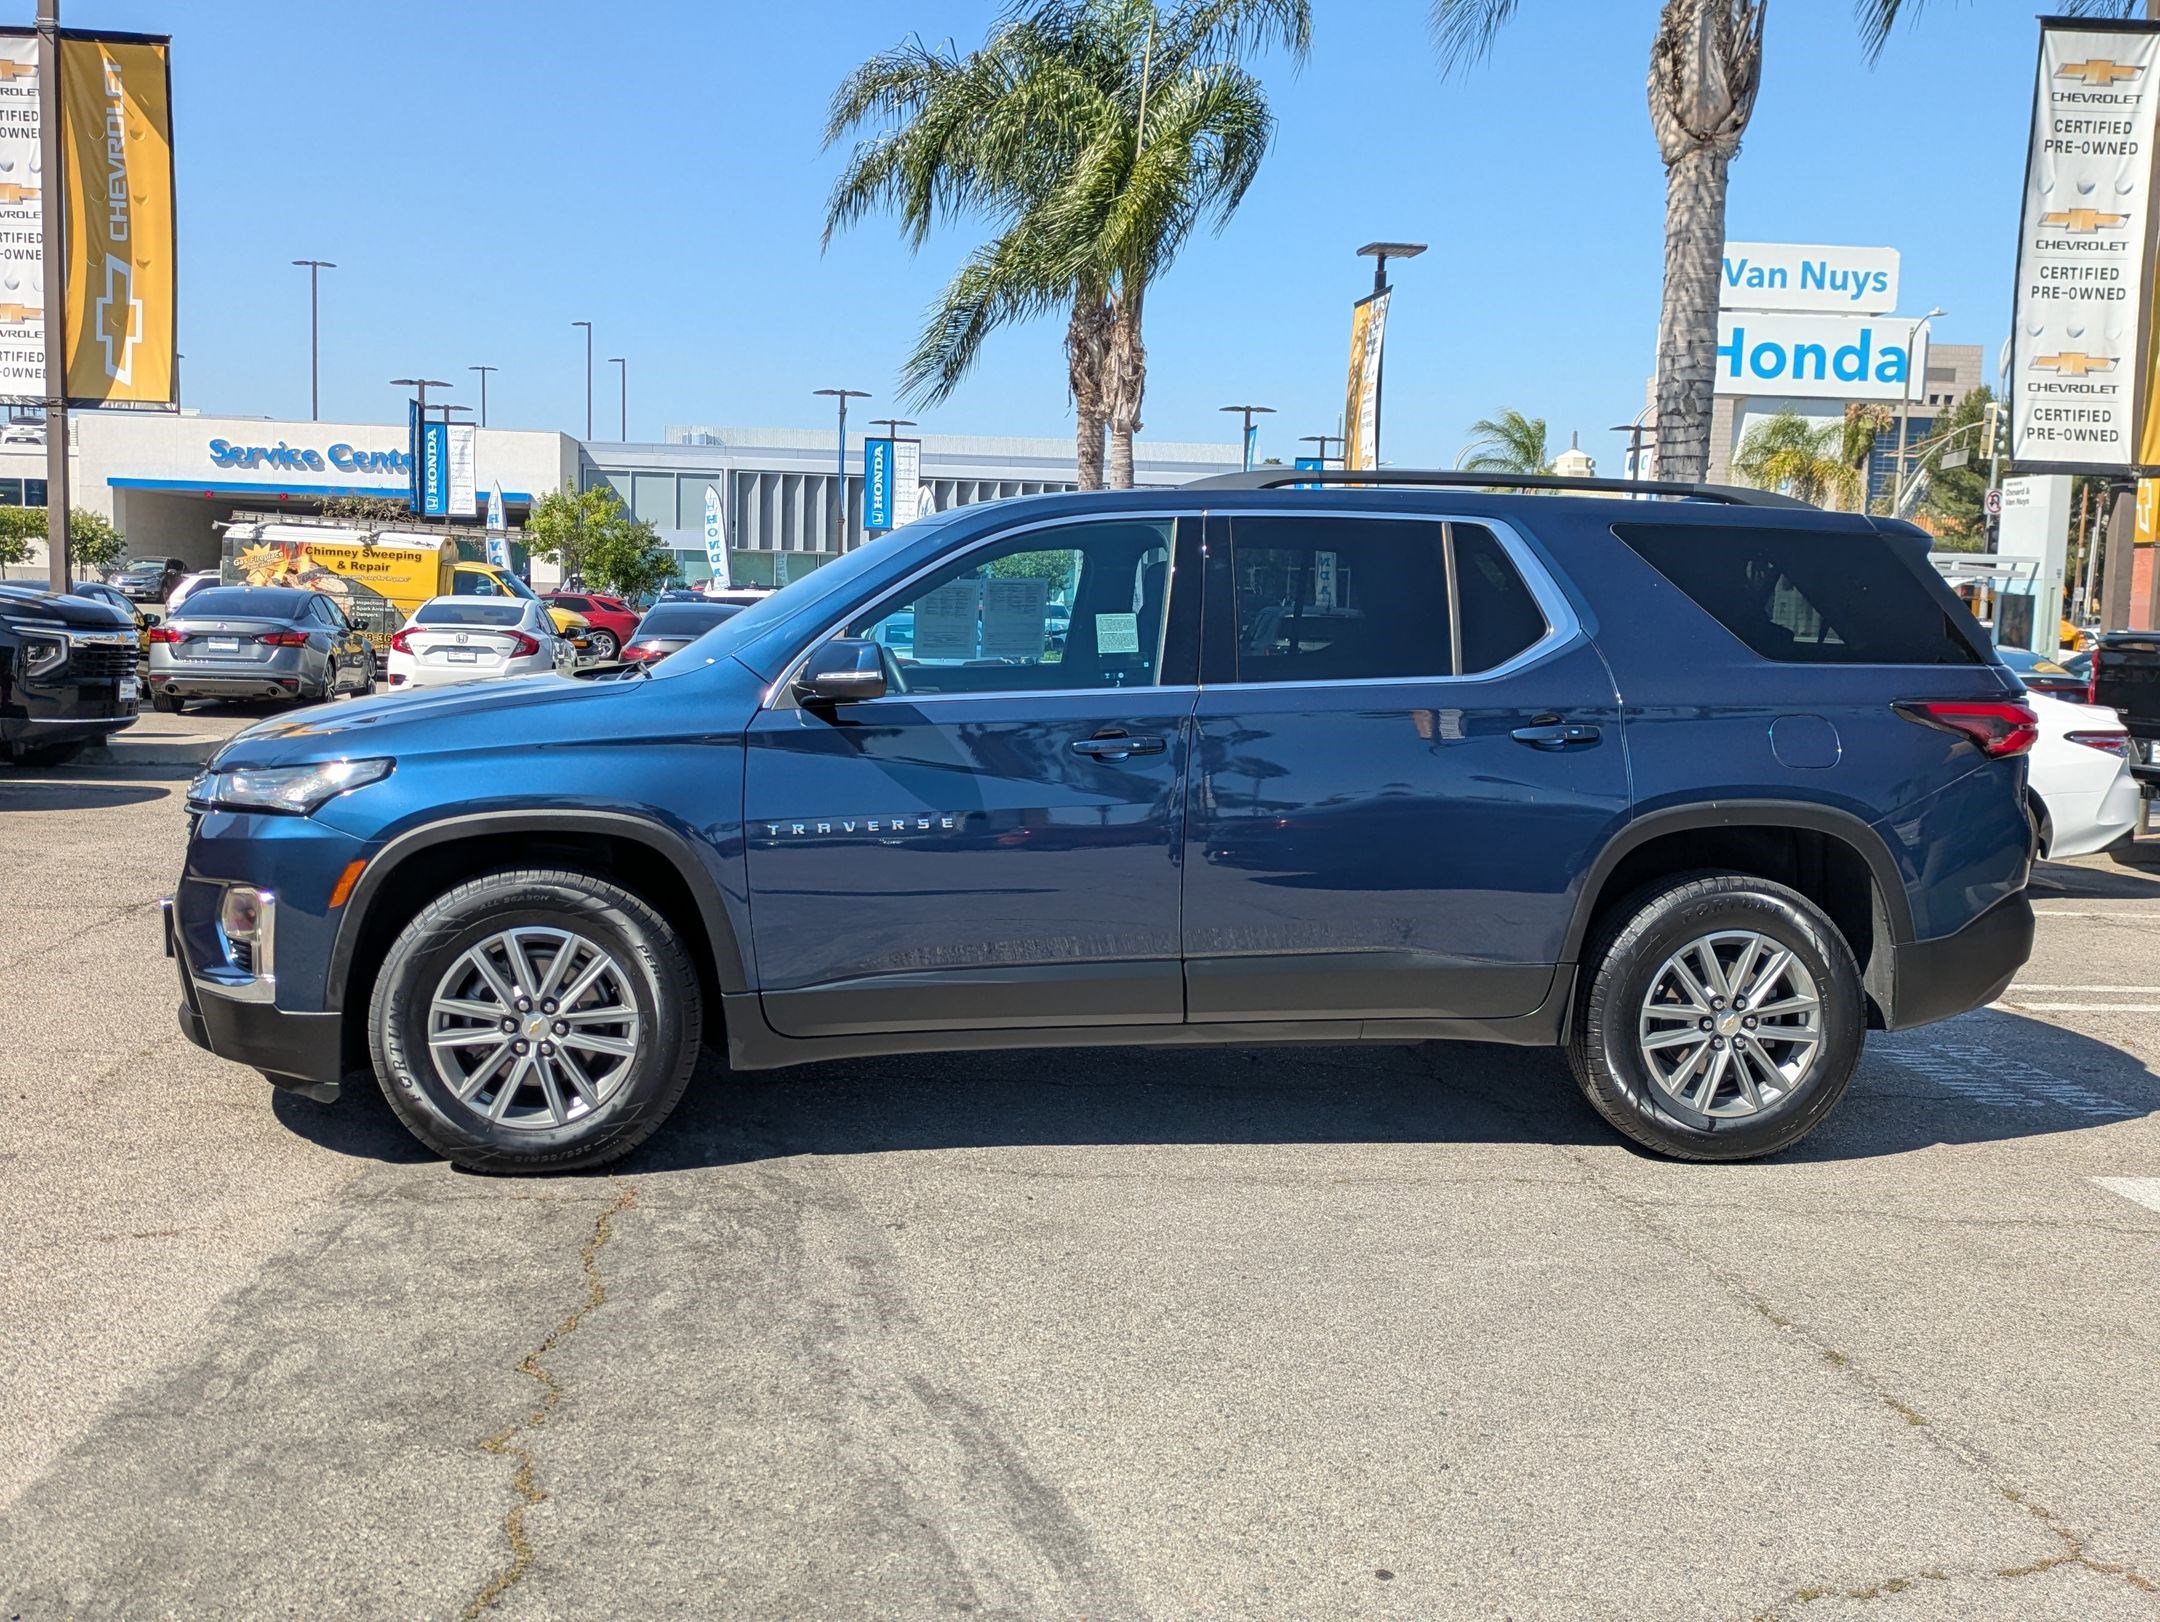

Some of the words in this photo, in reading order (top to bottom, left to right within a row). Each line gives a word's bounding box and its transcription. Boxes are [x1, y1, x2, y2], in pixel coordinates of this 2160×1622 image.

[2051, 92, 2143, 104] CHEVROLET
[0, 127, 41, 139] OWNE
[2054, 119, 2132, 135] CERTIFIED
[103, 57, 128, 241] CHEVROLET
[2044, 139, 2139, 155] PRE-OWNED
[0, 210, 42, 219] VROLE
[2035, 239, 2129, 252] CHEVROLET
[1722, 258, 1787, 288] Van
[1801, 261, 1888, 300] Nuys
[2040, 266, 2120, 281] CERTIFIED
[2031, 286, 2126, 301] PRE-OWNED
[0, 330, 44, 339] VROLE
[1717, 327, 1907, 383] Honda
[2027, 382, 2120, 395] CHEVROLET
[2034, 408, 2111, 423] CERTIFIED
[2027, 427, 2119, 442] PRE-OWNED
[209, 438, 323, 470] Service
[427, 427, 438, 494] HONDA
[873, 444, 884, 509] HONDA
[305, 546, 359, 558] Chimney
[362, 548, 422, 563] Sweeping
[337, 560, 346, 570] &
[351, 561, 391, 573] Repair
[767, 817, 953, 836] TRAVERSE
